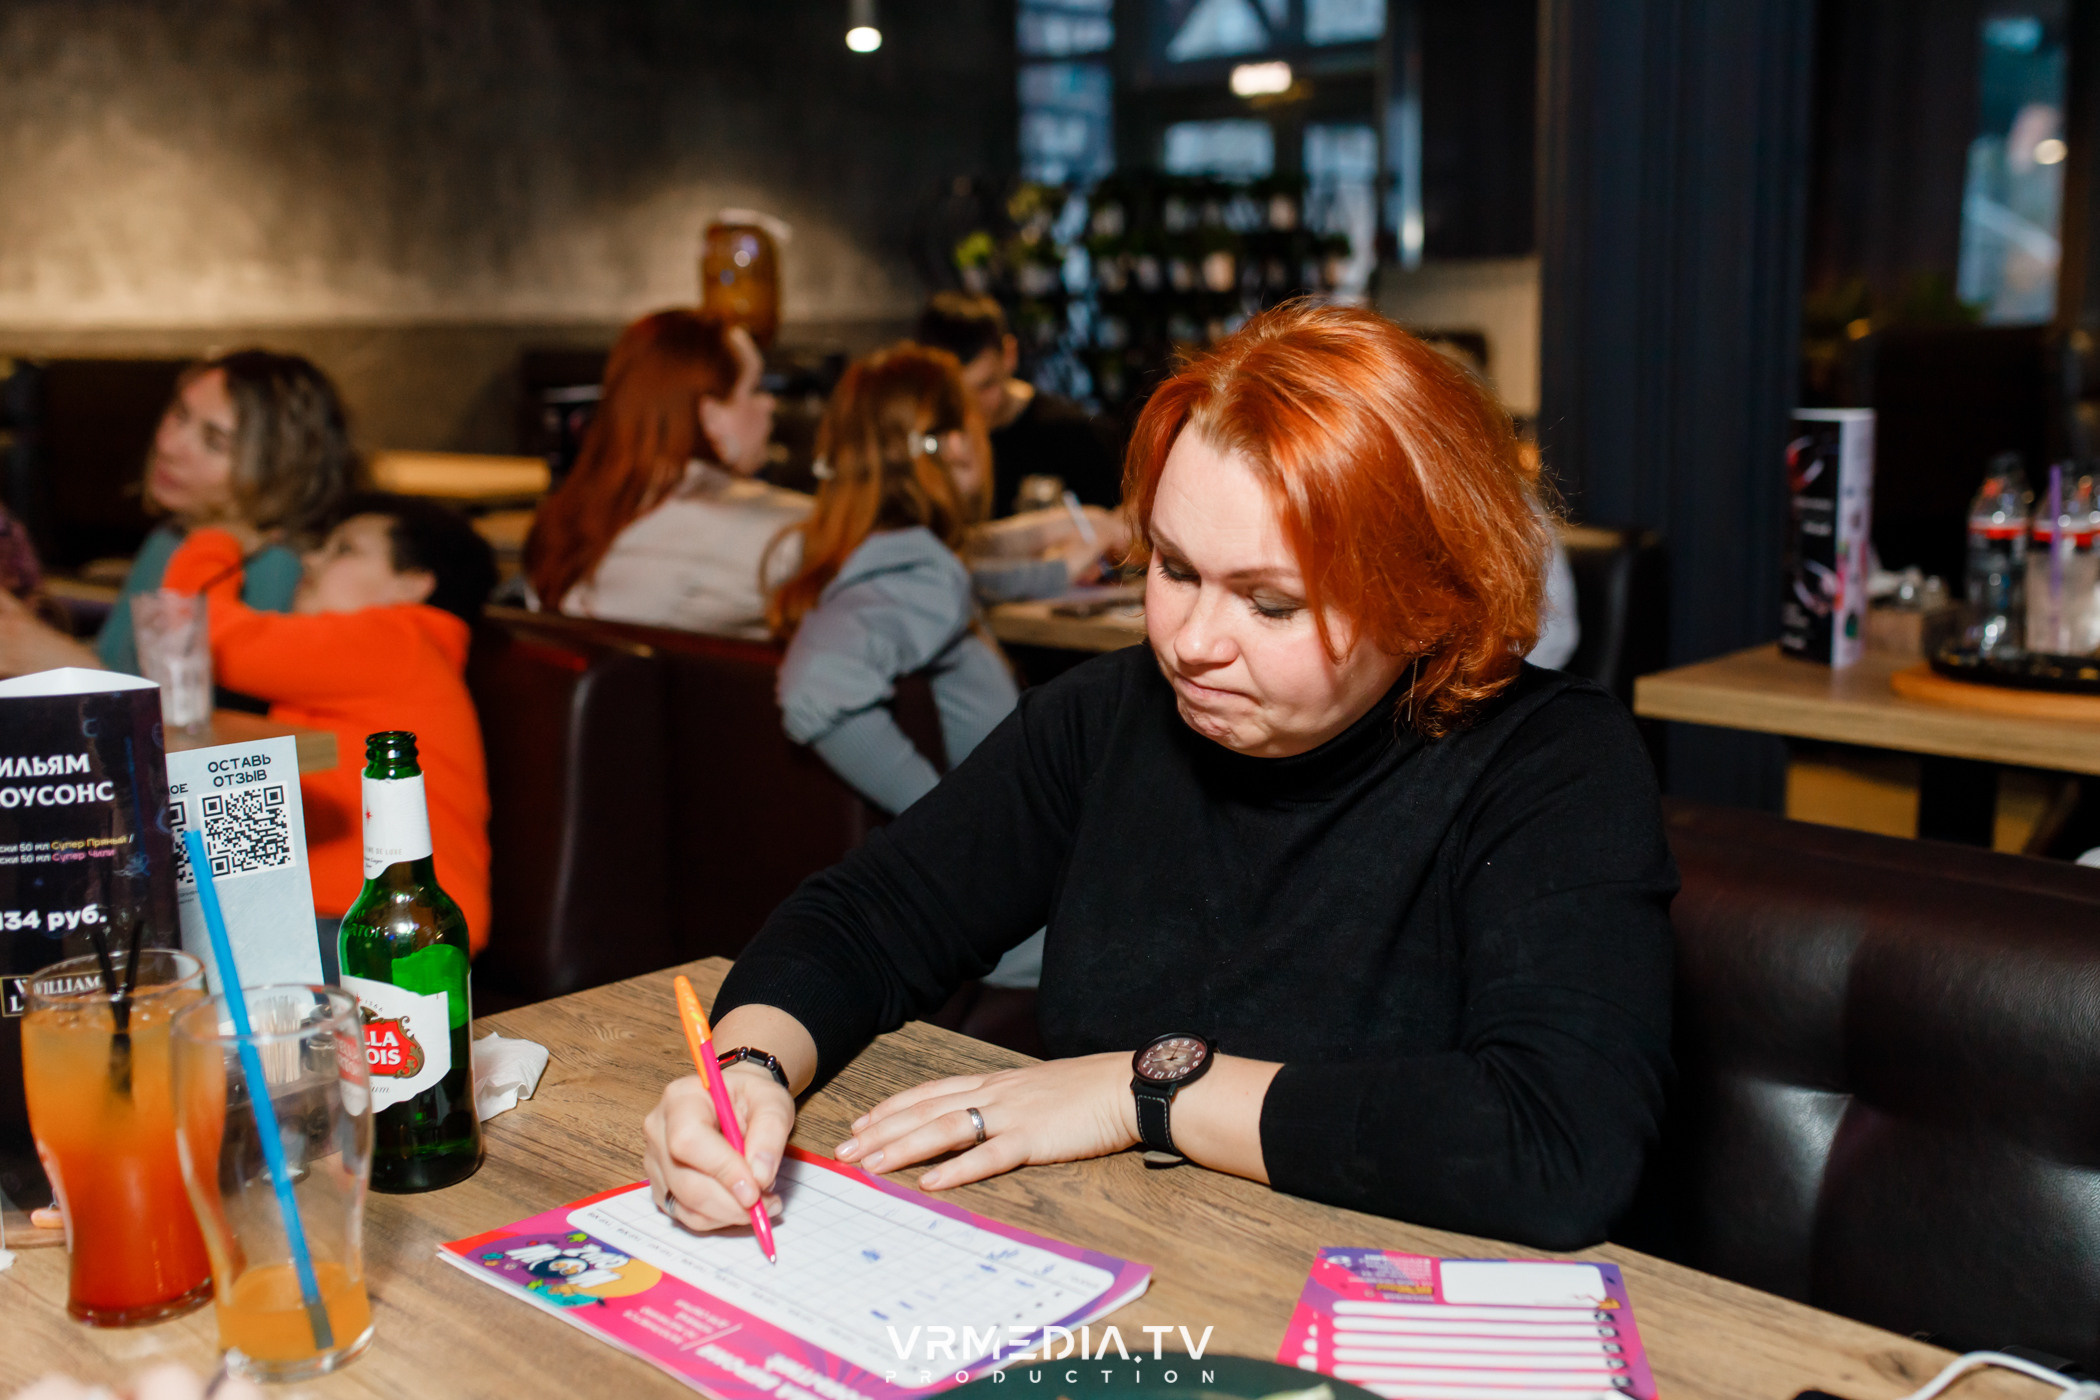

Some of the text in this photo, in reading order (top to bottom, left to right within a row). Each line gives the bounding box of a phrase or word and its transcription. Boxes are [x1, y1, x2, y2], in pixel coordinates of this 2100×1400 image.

[0, 753, 91, 778] ИЛЬЯМ
[208, 754, 271, 773] ОСТАВЬ
[213, 769, 267, 787] ОТЗЫВ
[0, 781, 115, 808] ОУСОНС
[0, 844, 18, 853] ски
[19, 842, 33, 852] 50
[51, 840, 86, 851] Супер
[0, 855, 19, 865] ски
[20, 853, 34, 863] 50
[51, 851, 86, 863] Супер
[88, 849, 116, 859] Чили
[47, 903, 107, 932] руб.
[362, 1030, 399, 1047] LLA
[366, 1048, 402, 1065] OIS
